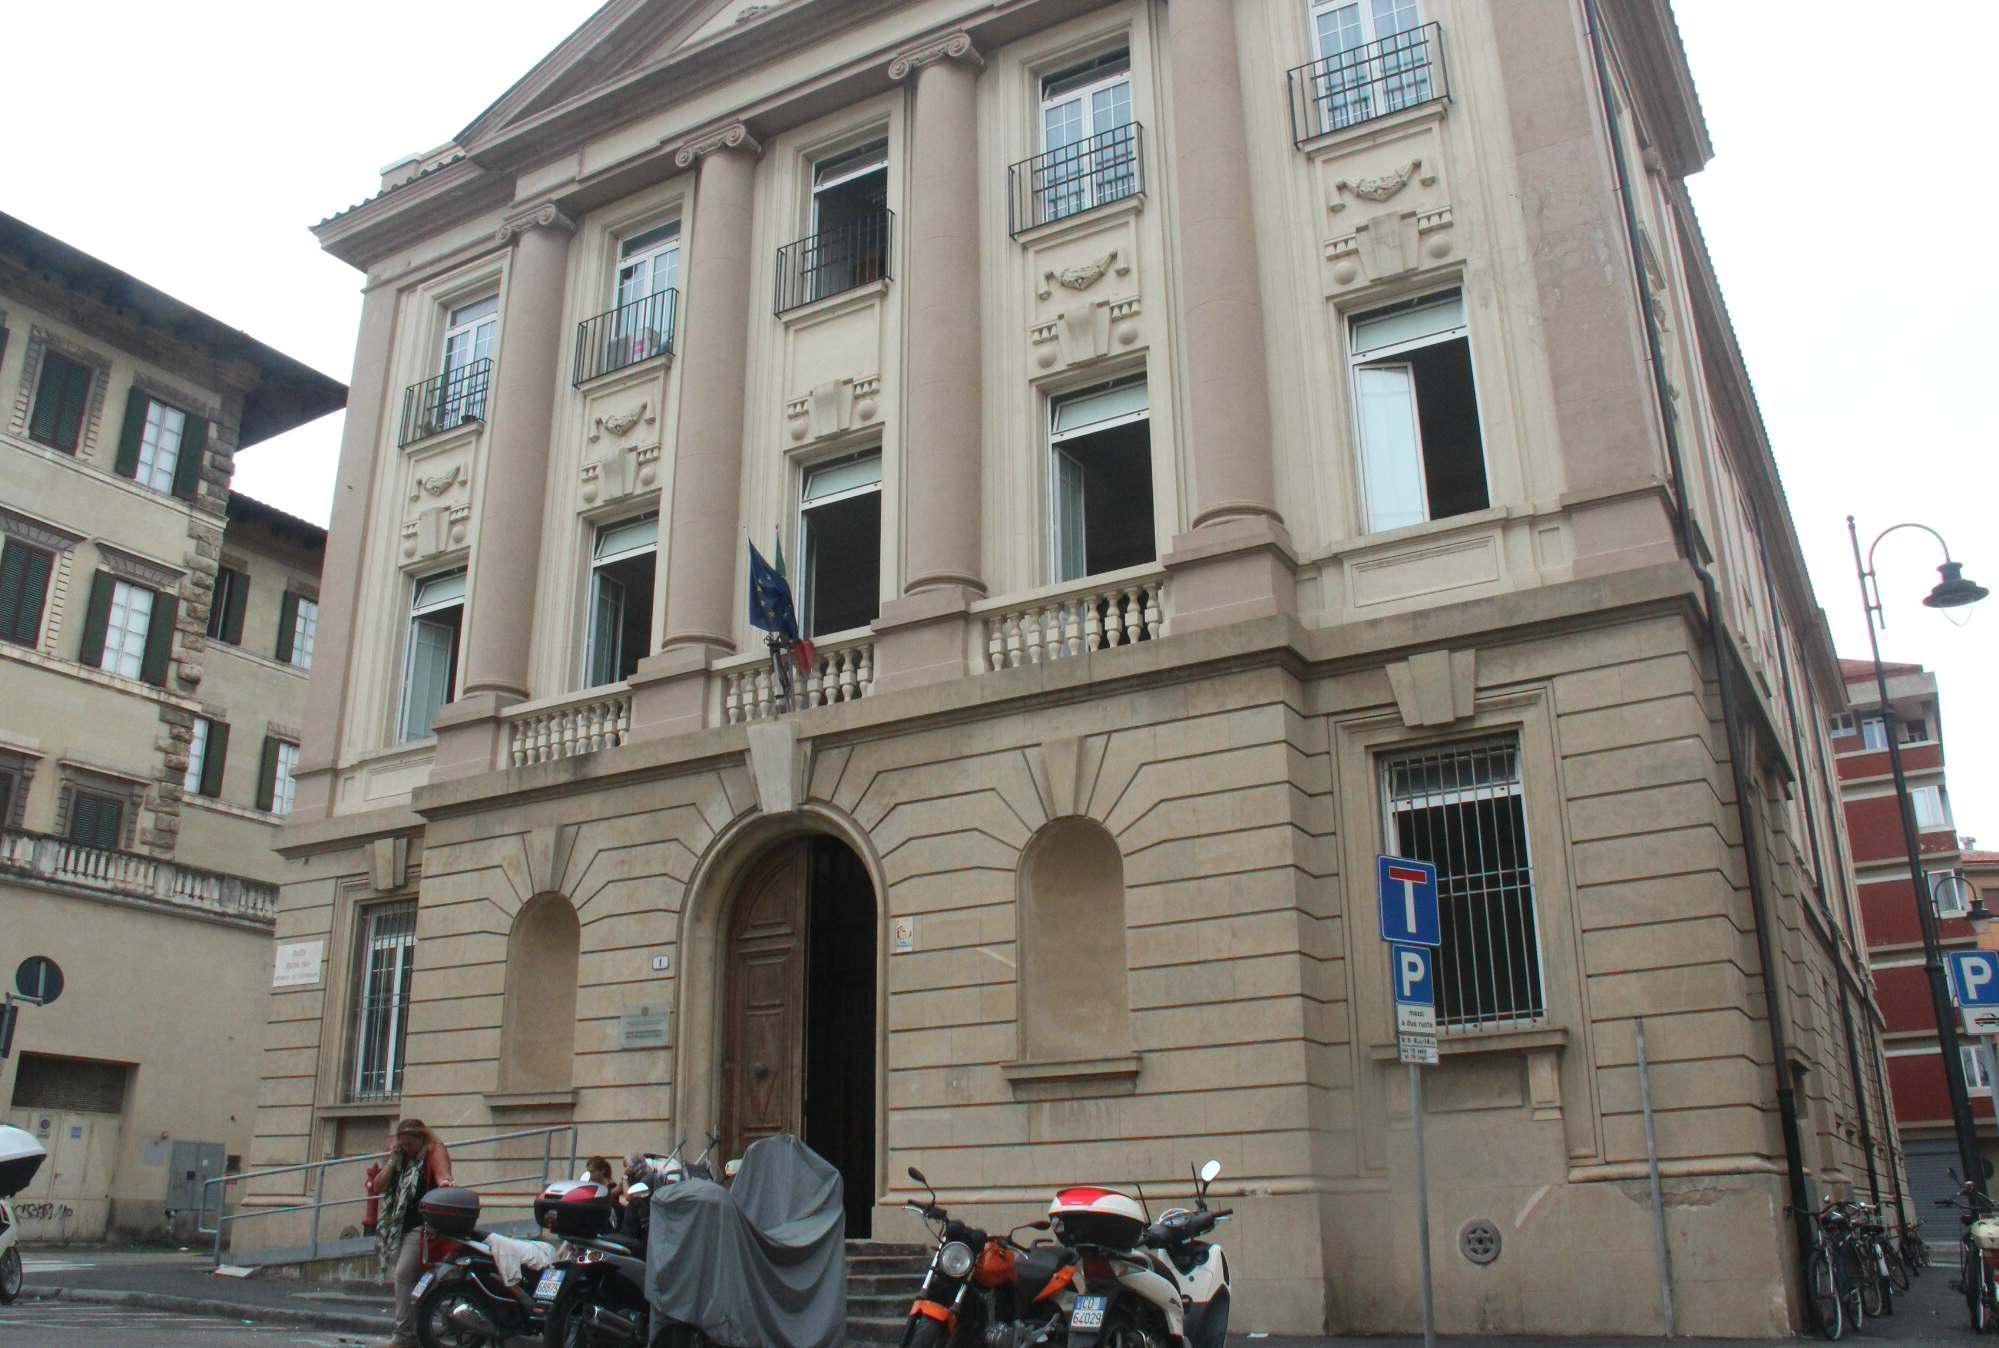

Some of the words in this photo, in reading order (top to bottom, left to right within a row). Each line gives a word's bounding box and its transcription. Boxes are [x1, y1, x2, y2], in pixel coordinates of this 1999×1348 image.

[1400, 951, 1425, 997] P
[1960, 956, 1993, 1000] P
[1072, 1311, 1102, 1325] 64029
